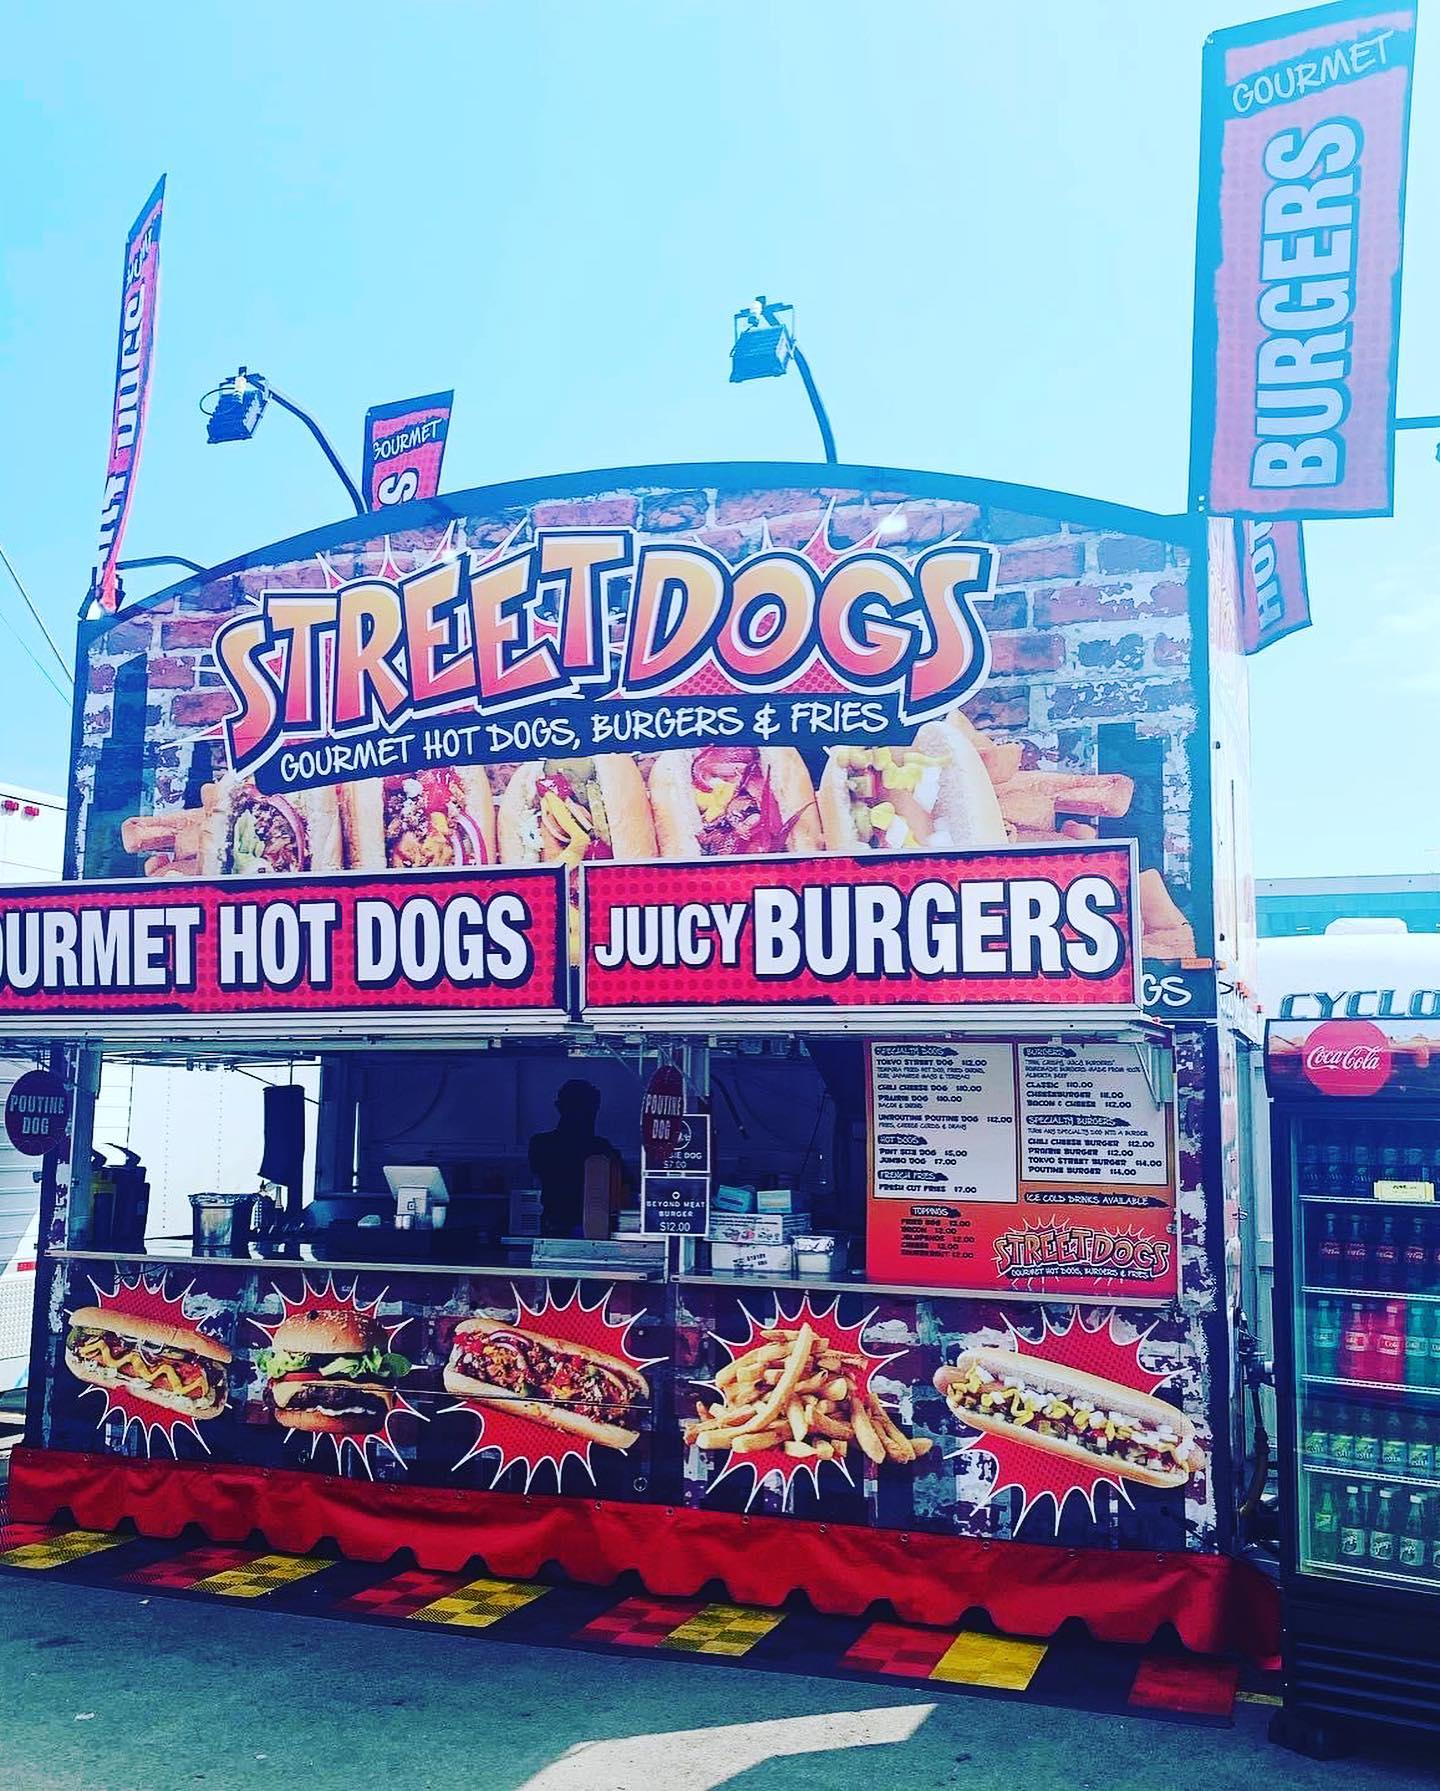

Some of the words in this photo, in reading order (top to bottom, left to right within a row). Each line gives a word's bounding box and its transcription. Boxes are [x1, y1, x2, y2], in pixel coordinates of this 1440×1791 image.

[1232, 30, 1397, 113] GOURMET
[1250, 121, 1358, 488] BURGERS
[280, 734, 414, 782] GOURMET
[422, 728, 480, 761] HOT
[490, 717, 582, 753] DOGS,
[591, 704, 744, 744] BURGERS
[753, 706, 780, 737] &
[790, 701, 890, 733] FRIES
[594, 903, 750, 966] JUICY
[754, 876, 1120, 976] BURGERS
[0, 905, 201, 989] URMET
[219, 901, 338, 985] HOT
[356, 894, 529, 983] DOGS
[10, 1095, 65, 1114] POUTINE
[645, 1094, 682, 1115] POUTINE
[22, 1117, 49, 1134] DOG
[652, 1119, 671, 1139] DOG
[684, 1151, 702, 1159] DOG
[1026, 1194, 1041, 1202] ICE
[1042, 1195, 1066, 1203] COLD
[1068, 1196, 1100, 1204] DRINKS
[1103, 1196, 1149, 1205] AVAILABLE
[659, 1222, 691, 1231] $12.00
